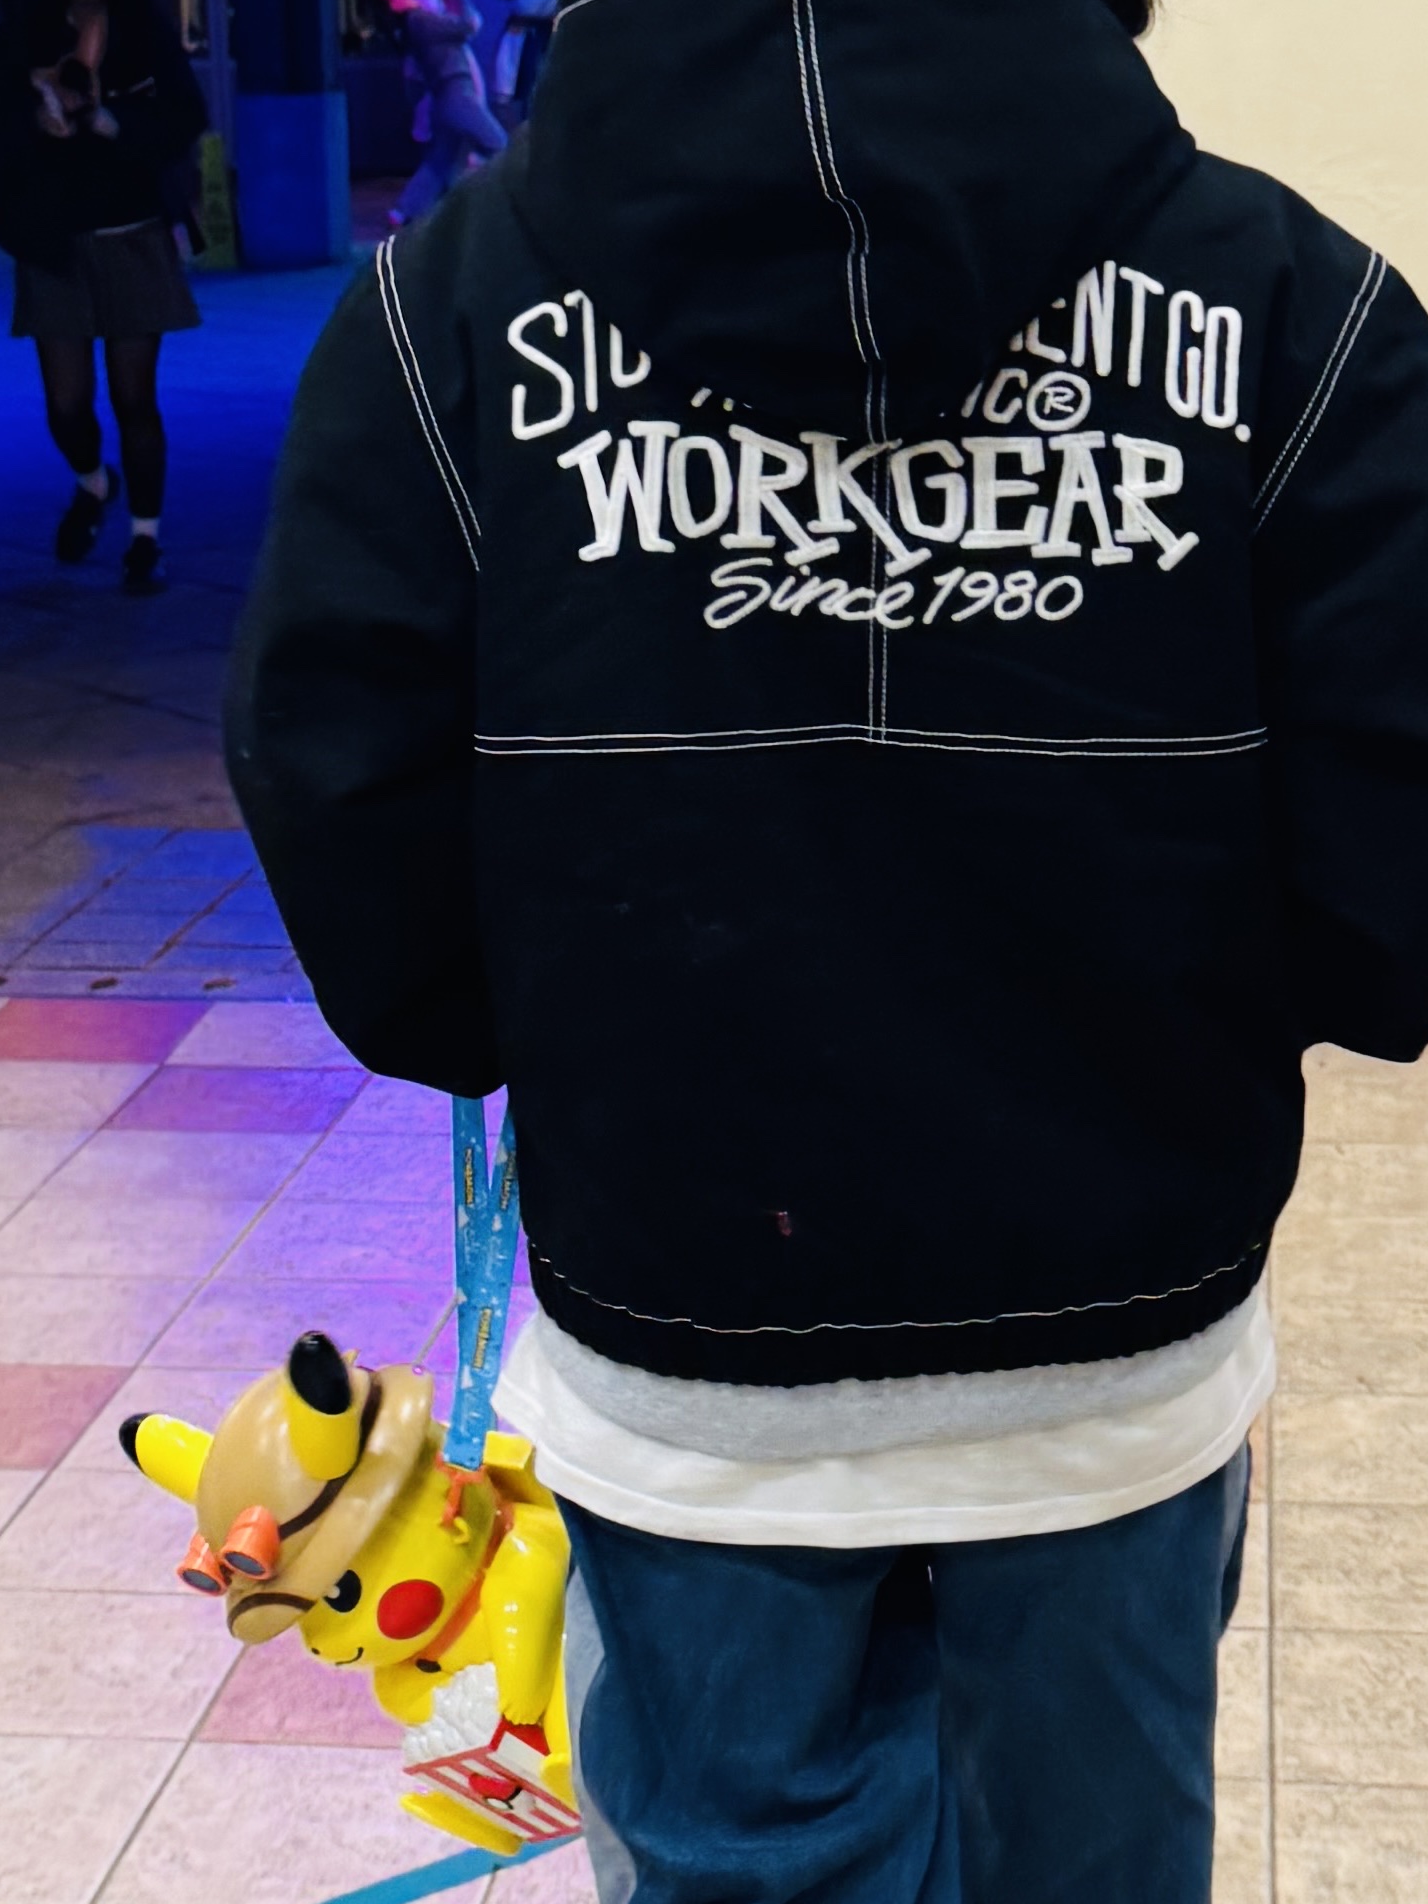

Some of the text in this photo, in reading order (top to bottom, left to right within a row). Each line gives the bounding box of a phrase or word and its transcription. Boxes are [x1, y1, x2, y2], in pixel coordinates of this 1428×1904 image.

[557, 421, 1199, 576] WORKGEAR
[703, 558, 1084, 629] Since 1980
